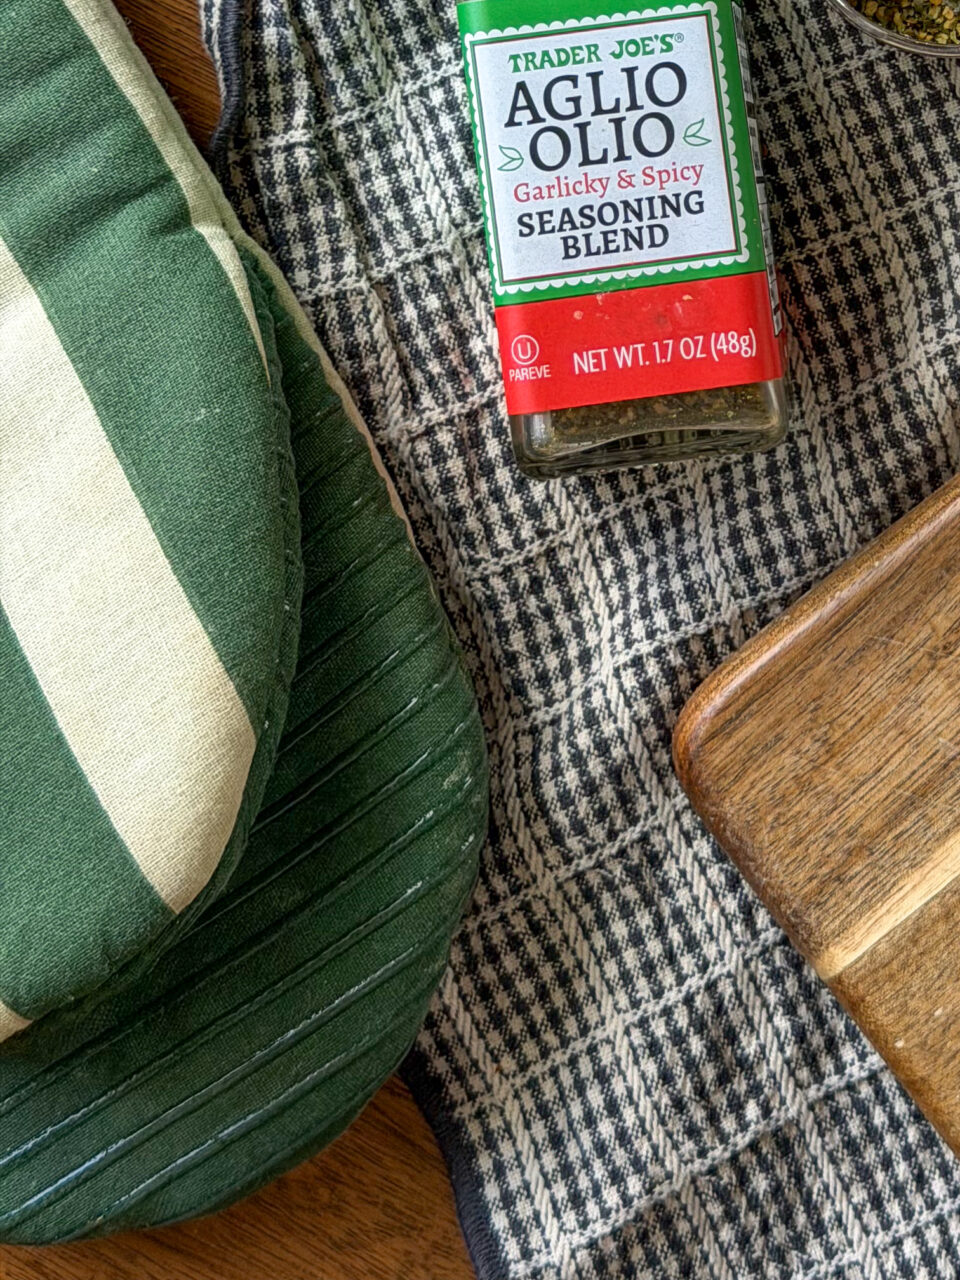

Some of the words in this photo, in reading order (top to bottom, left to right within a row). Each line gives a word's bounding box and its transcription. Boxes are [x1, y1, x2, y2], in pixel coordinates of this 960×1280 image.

[507, 43, 602, 73] TRADER
[504, 61, 687, 128] AGLIO
[529, 111, 675, 172] OLIO
[513, 172, 610, 203] Garlicky
[617, 168, 636, 189] &
[642, 162, 704, 190] Spicy
[517, 190, 705, 238] SEASONING
[560, 223, 669, 260] BLEND
[508, 364, 552, 382] PAREVE
[572, 348, 608, 375] NET
[613, 343, 650, 369] WT.
[652, 339, 674, 364] 1.7
[679, 335, 707, 360] OZ
[710, 327, 757, 362] (48g)
